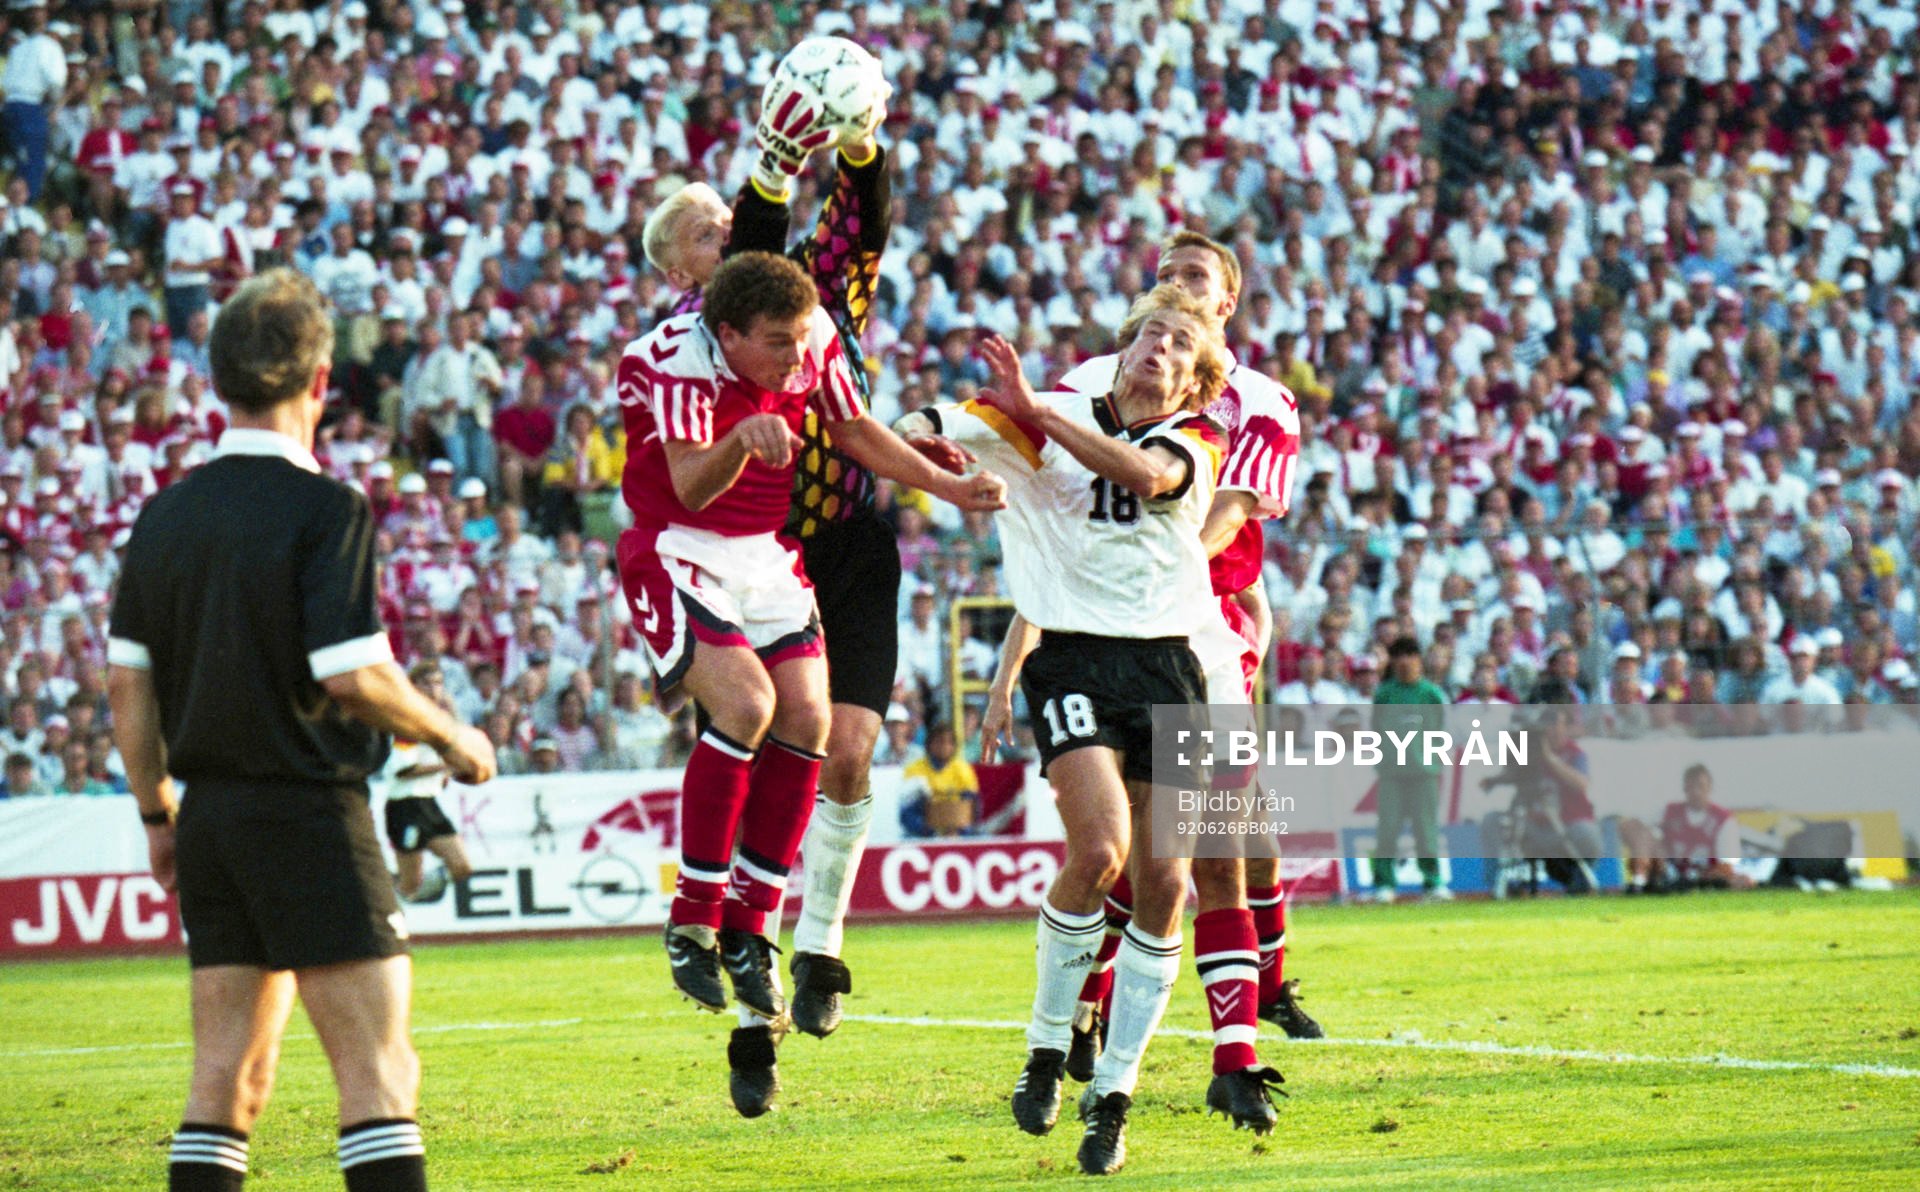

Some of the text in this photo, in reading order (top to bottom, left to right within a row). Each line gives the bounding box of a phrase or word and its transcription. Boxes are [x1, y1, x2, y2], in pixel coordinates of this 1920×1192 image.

[1089, 475, 1141, 525] 18
[1043, 694, 1098, 746] 18
[881, 847, 1058, 912] Coca
[12, 878, 170, 945] JVC
